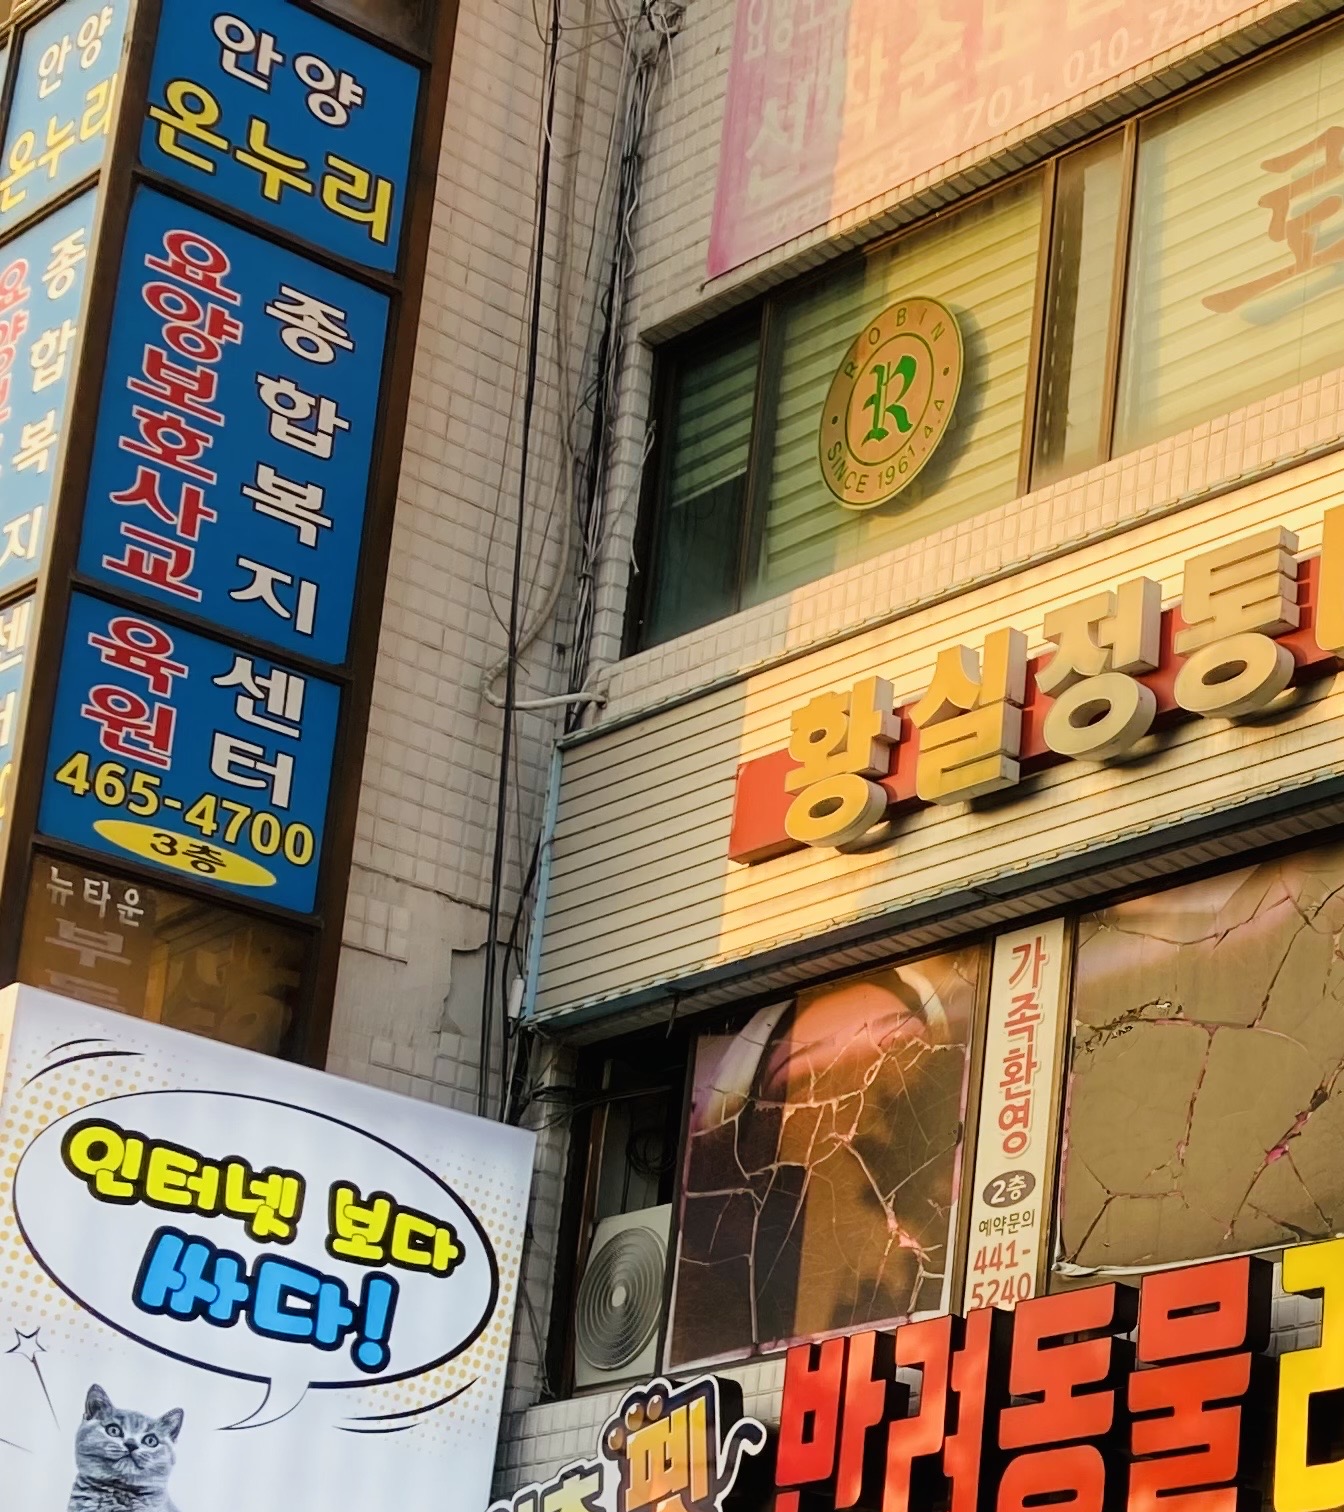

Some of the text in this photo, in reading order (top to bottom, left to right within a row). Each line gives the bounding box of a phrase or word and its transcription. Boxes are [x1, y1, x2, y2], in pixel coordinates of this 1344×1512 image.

[36, 7, 114, 101] 안양
[210, 11, 366, 128] 안양
[0, 72, 119, 214] 온누리
[147, 78, 394, 245] 온누리
[842, 306, 946, 380] ROBIN
[826, 440, 870, 494] SINCE
[55, 752, 315, 867] 465-4700
[150, 831, 228, 875] 3층
[46, 865, 145, 928] 뉴타운
[997, 935, 1047, 1155] 가족환영
[61, 1117, 466, 1279] 인터넷 보다
[978, 1208, 1037, 1238] 예약문의
[990, 1174, 1029, 1206] 2층
[131, 1225, 401, 1374] 싸다!
[970, 1272, 1033, 1309] 5240
[972, 1239, 1032, 1276] 441-
